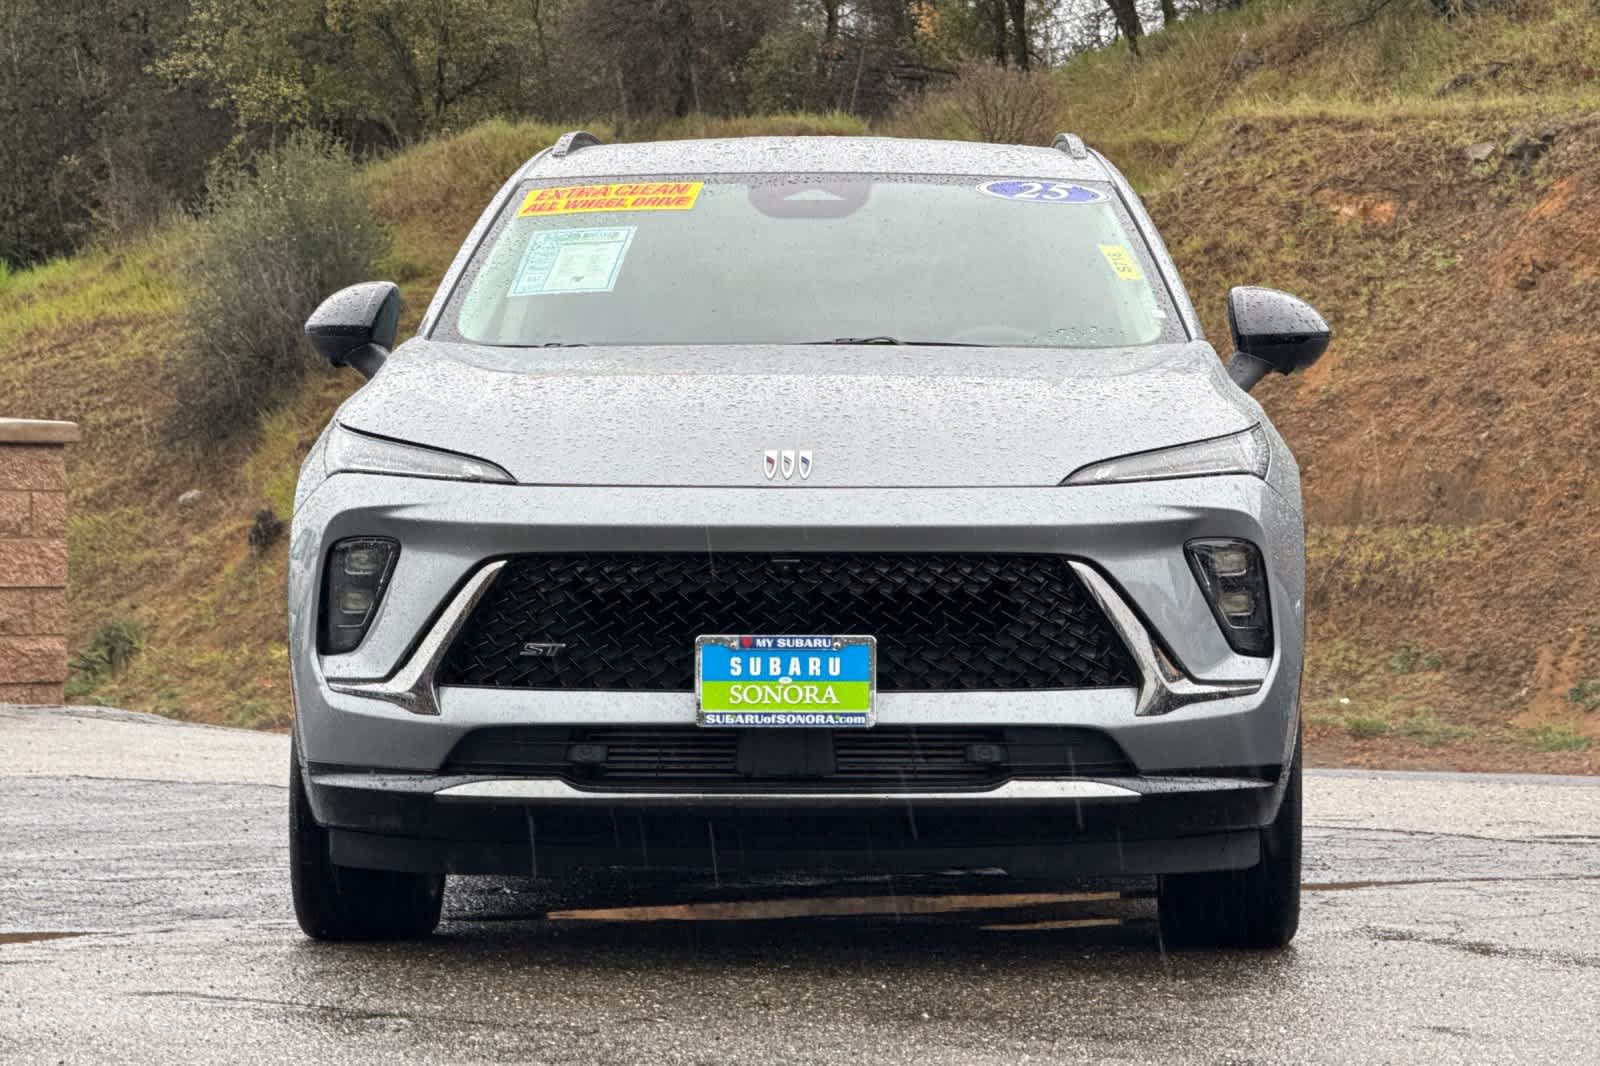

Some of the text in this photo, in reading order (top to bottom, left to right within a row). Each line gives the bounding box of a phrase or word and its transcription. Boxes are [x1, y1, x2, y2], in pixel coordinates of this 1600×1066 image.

[536, 183, 692, 201] EXTRA CLEAN
[1015, 182, 1073, 200] 25
[523, 196, 690, 214] ALL WHEEL DRIVE
[519, 642, 566, 657] ST
[755, 637, 832, 648] MY SUBARU
[729, 656, 841, 677] SUBARU
[728, 684, 841, 705] SONORA
[705, 713, 866, 725] SUBARUofSONORA.com
